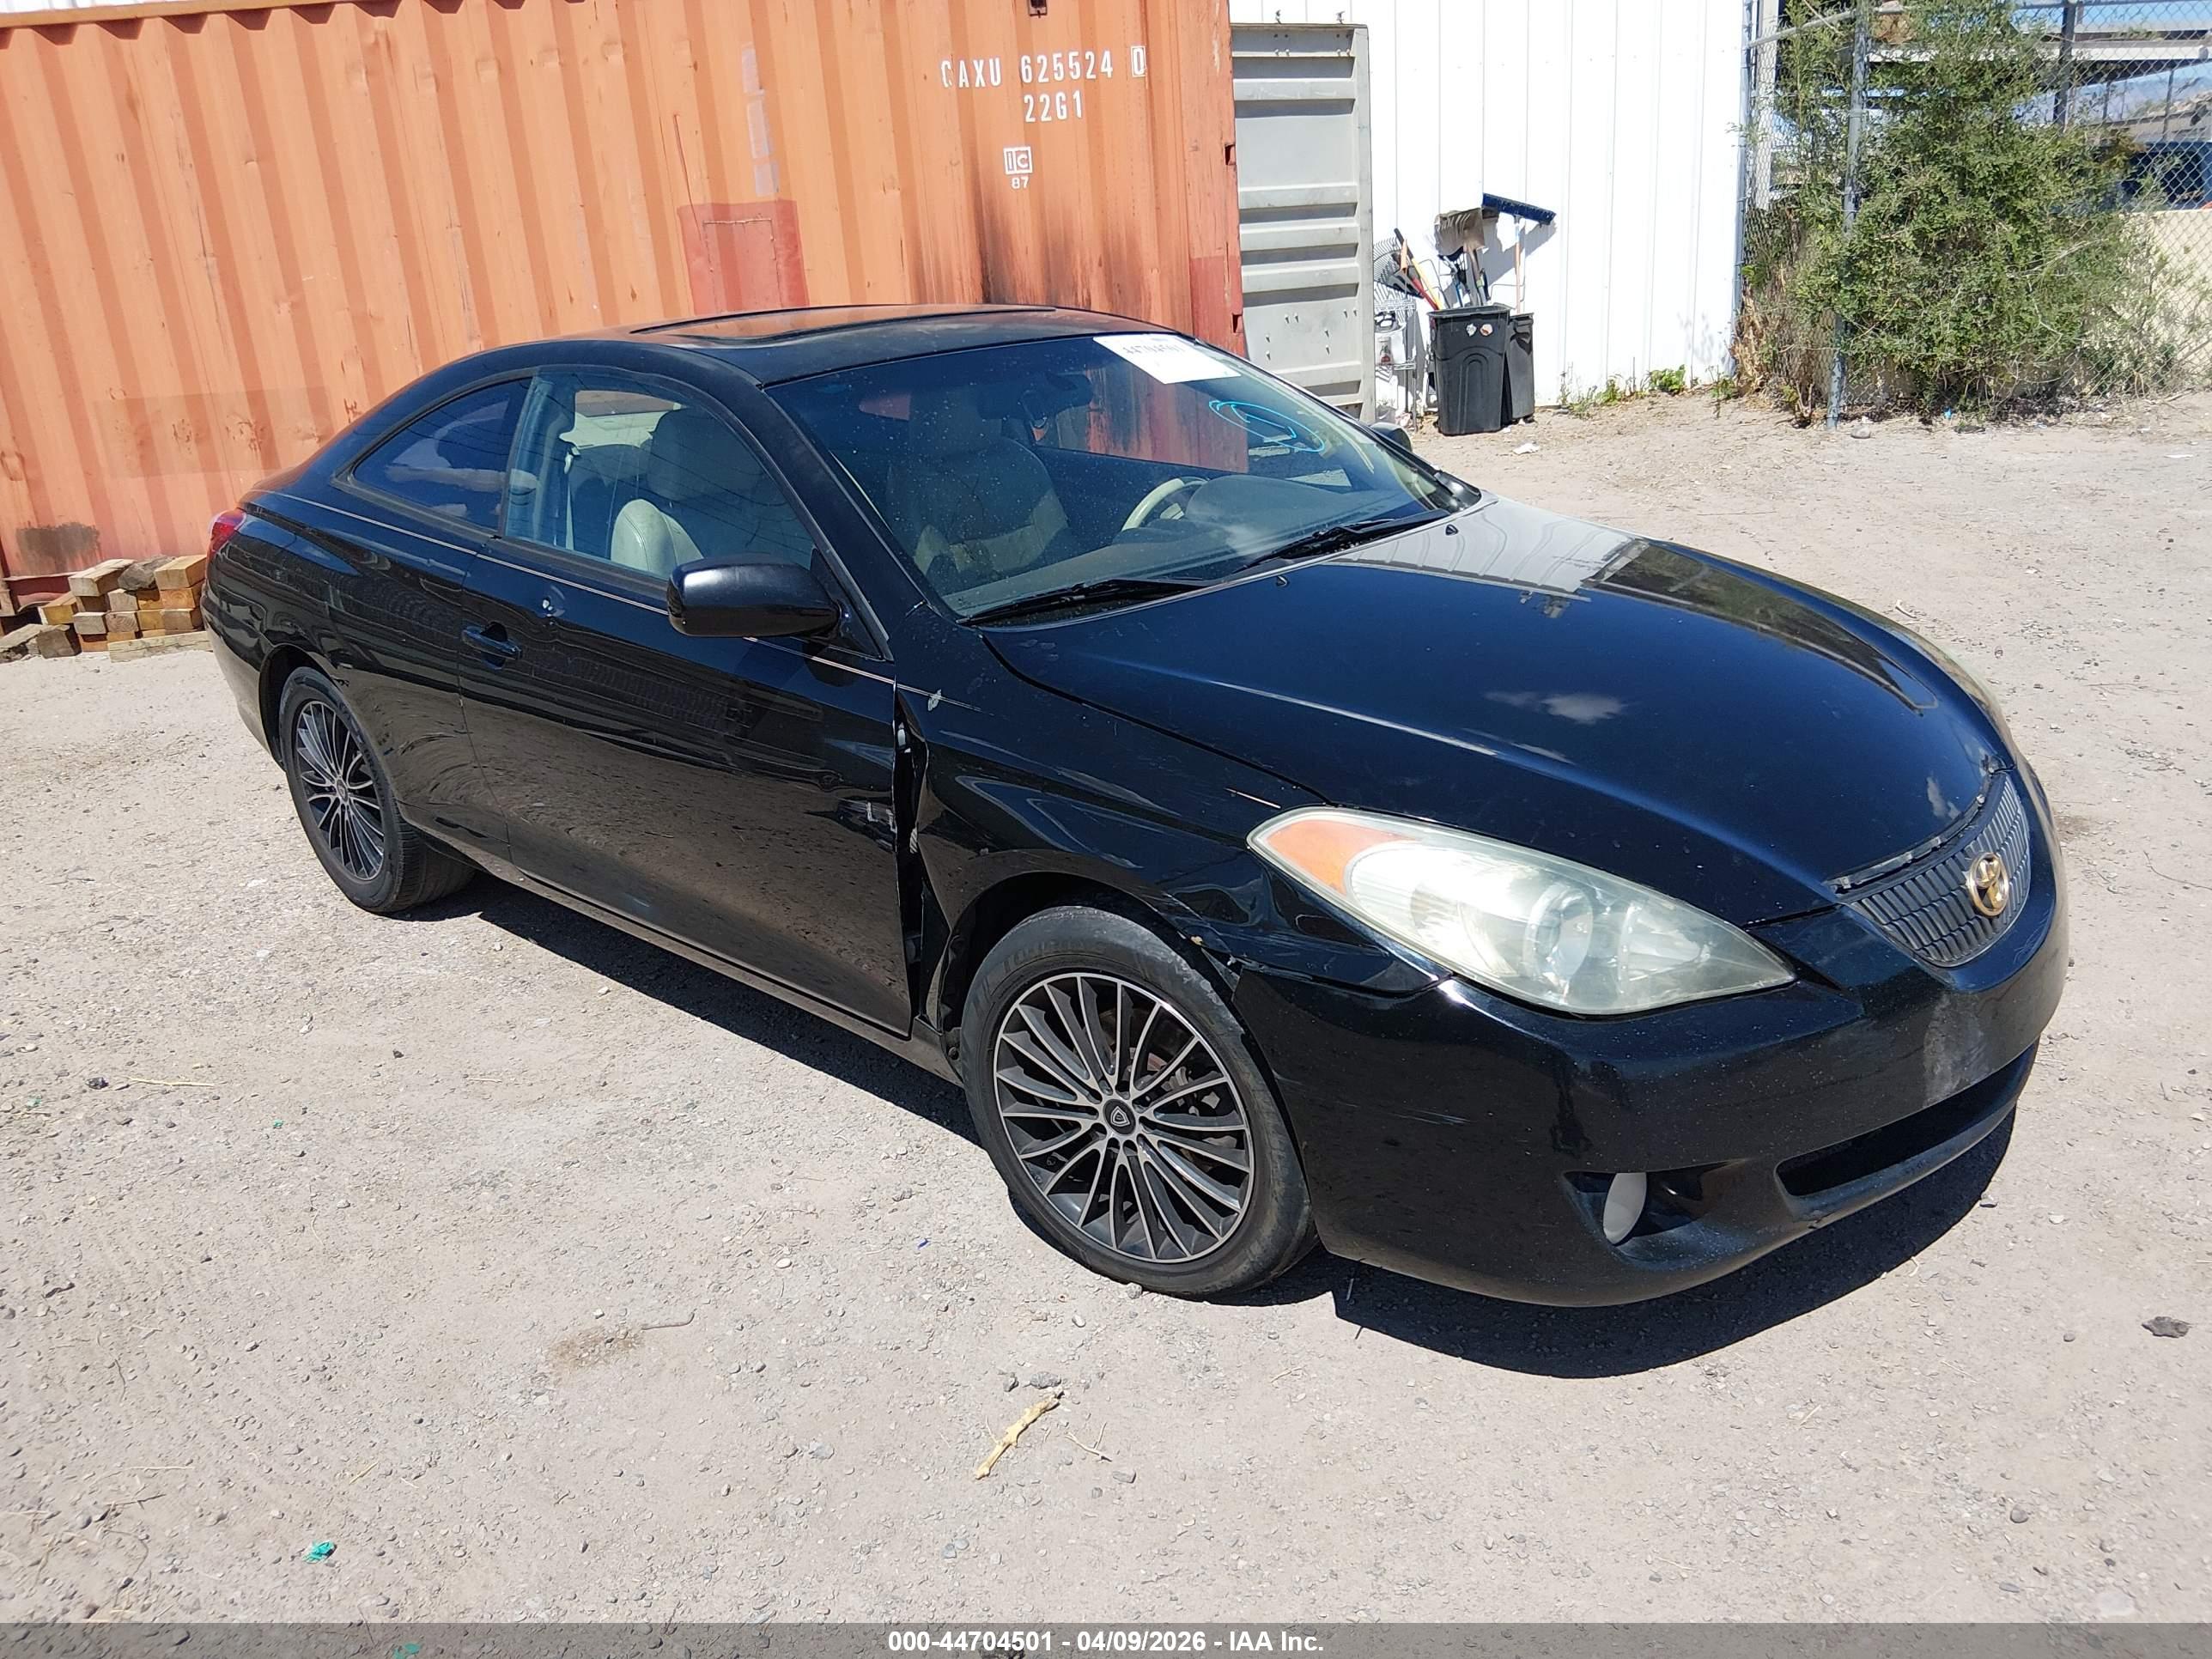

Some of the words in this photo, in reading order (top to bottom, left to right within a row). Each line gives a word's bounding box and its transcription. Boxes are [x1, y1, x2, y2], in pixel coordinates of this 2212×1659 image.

[1020, 50, 1114, 84] 625524
[1024, 90, 1082, 123] 22G1
[1012, 176, 1029, 190] 87
